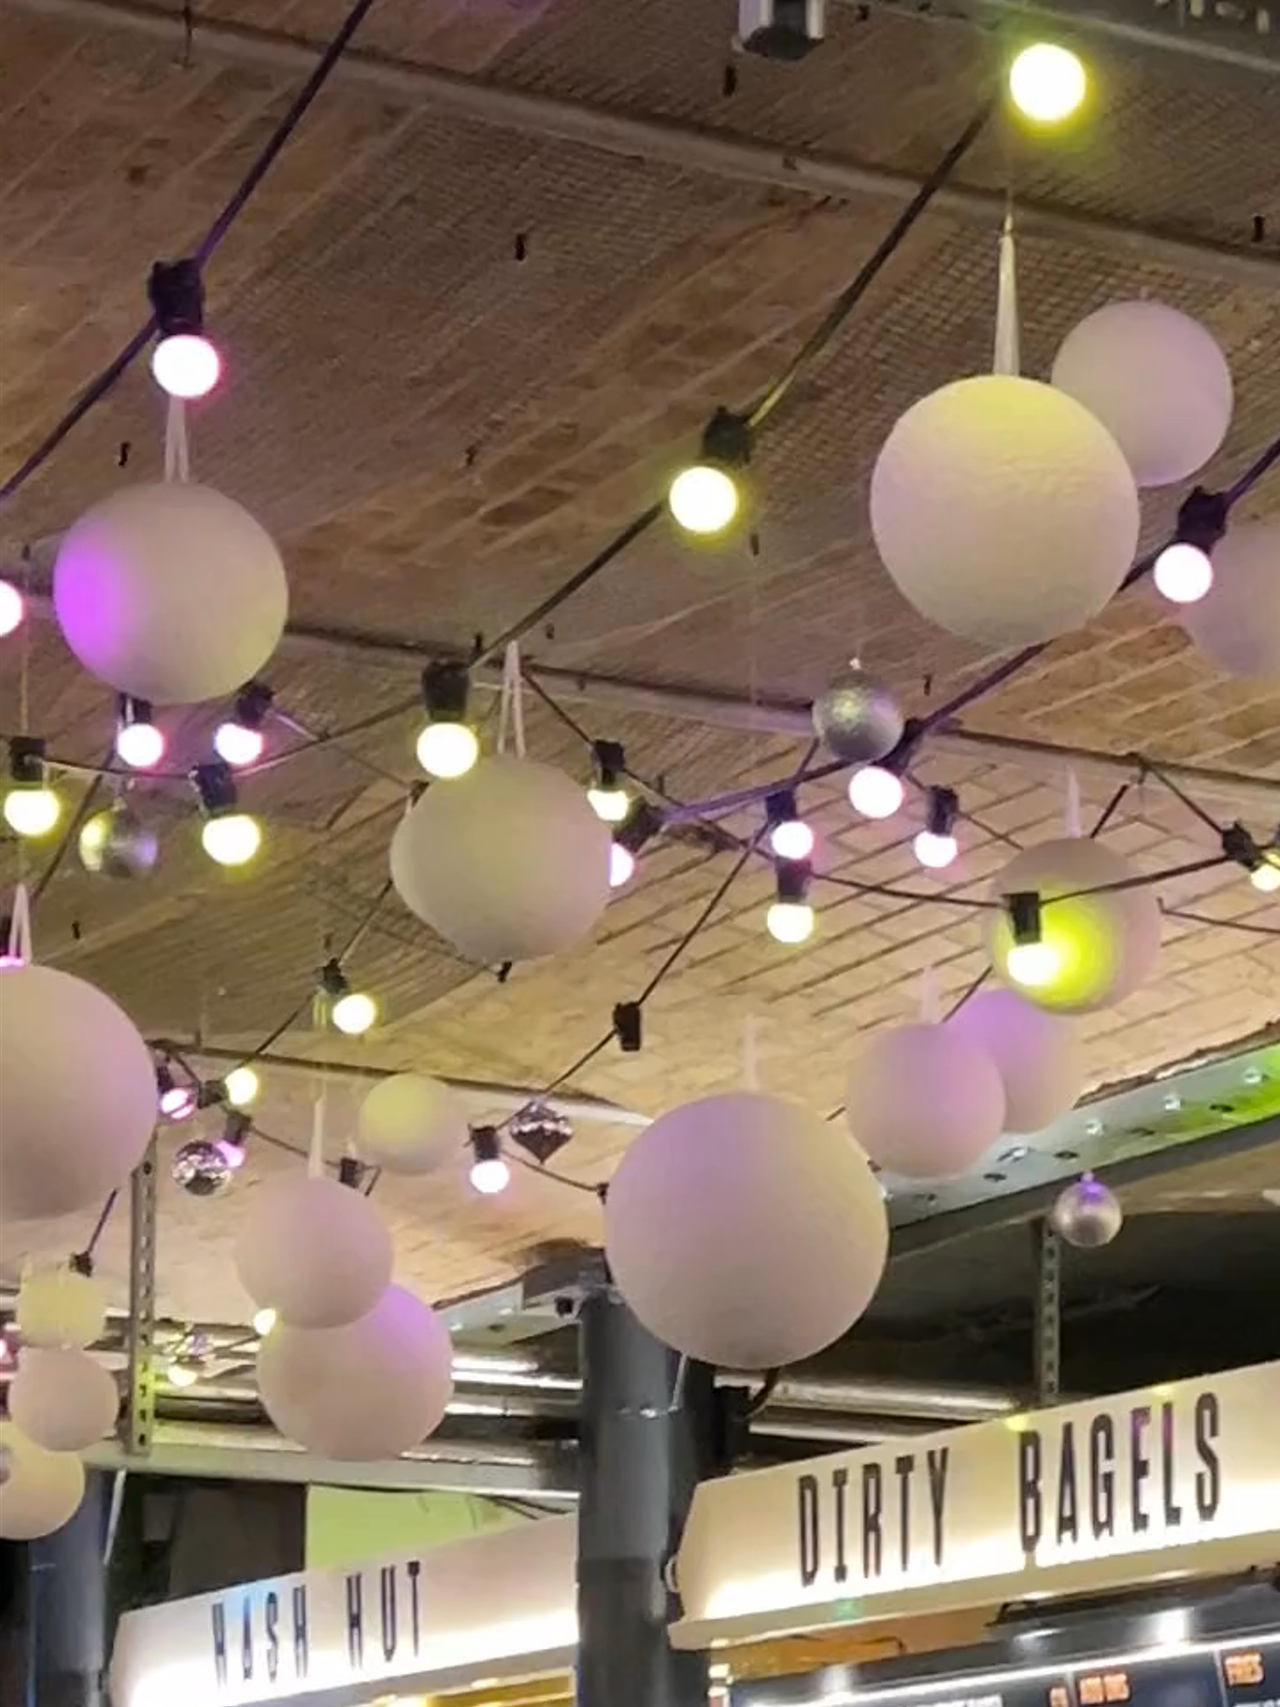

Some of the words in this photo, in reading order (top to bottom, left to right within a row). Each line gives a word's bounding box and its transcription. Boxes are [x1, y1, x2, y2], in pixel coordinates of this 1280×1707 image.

[799, 1446, 949, 1588] DIRTY
[1019, 1392, 1221, 1555] BAGELS
[346, 1560, 421, 1670] HUT
